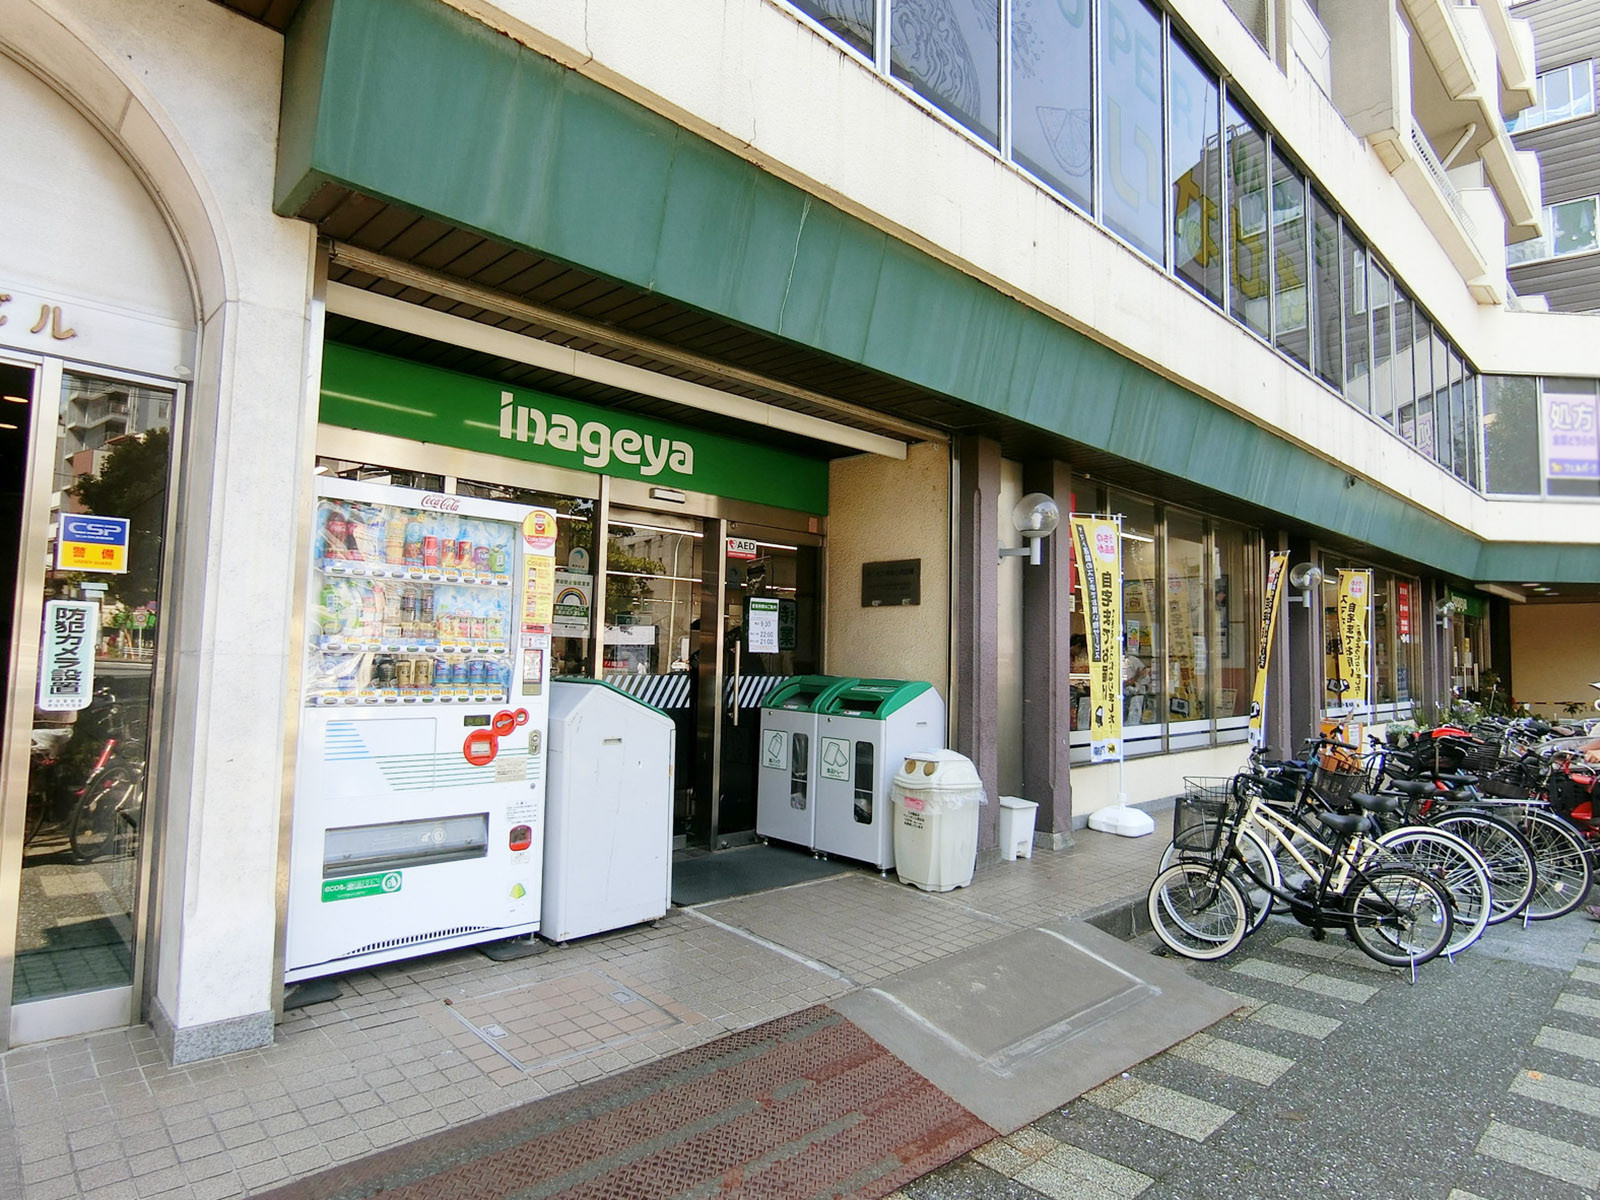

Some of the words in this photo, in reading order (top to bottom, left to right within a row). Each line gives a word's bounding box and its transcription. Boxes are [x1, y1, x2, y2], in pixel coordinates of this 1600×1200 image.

[500, 391, 694, 476] inageya
[68, 522, 122, 536] CSP
[737, 541, 755, 550] AED
[50, 607, 86, 695] 防犯カメラ設置
